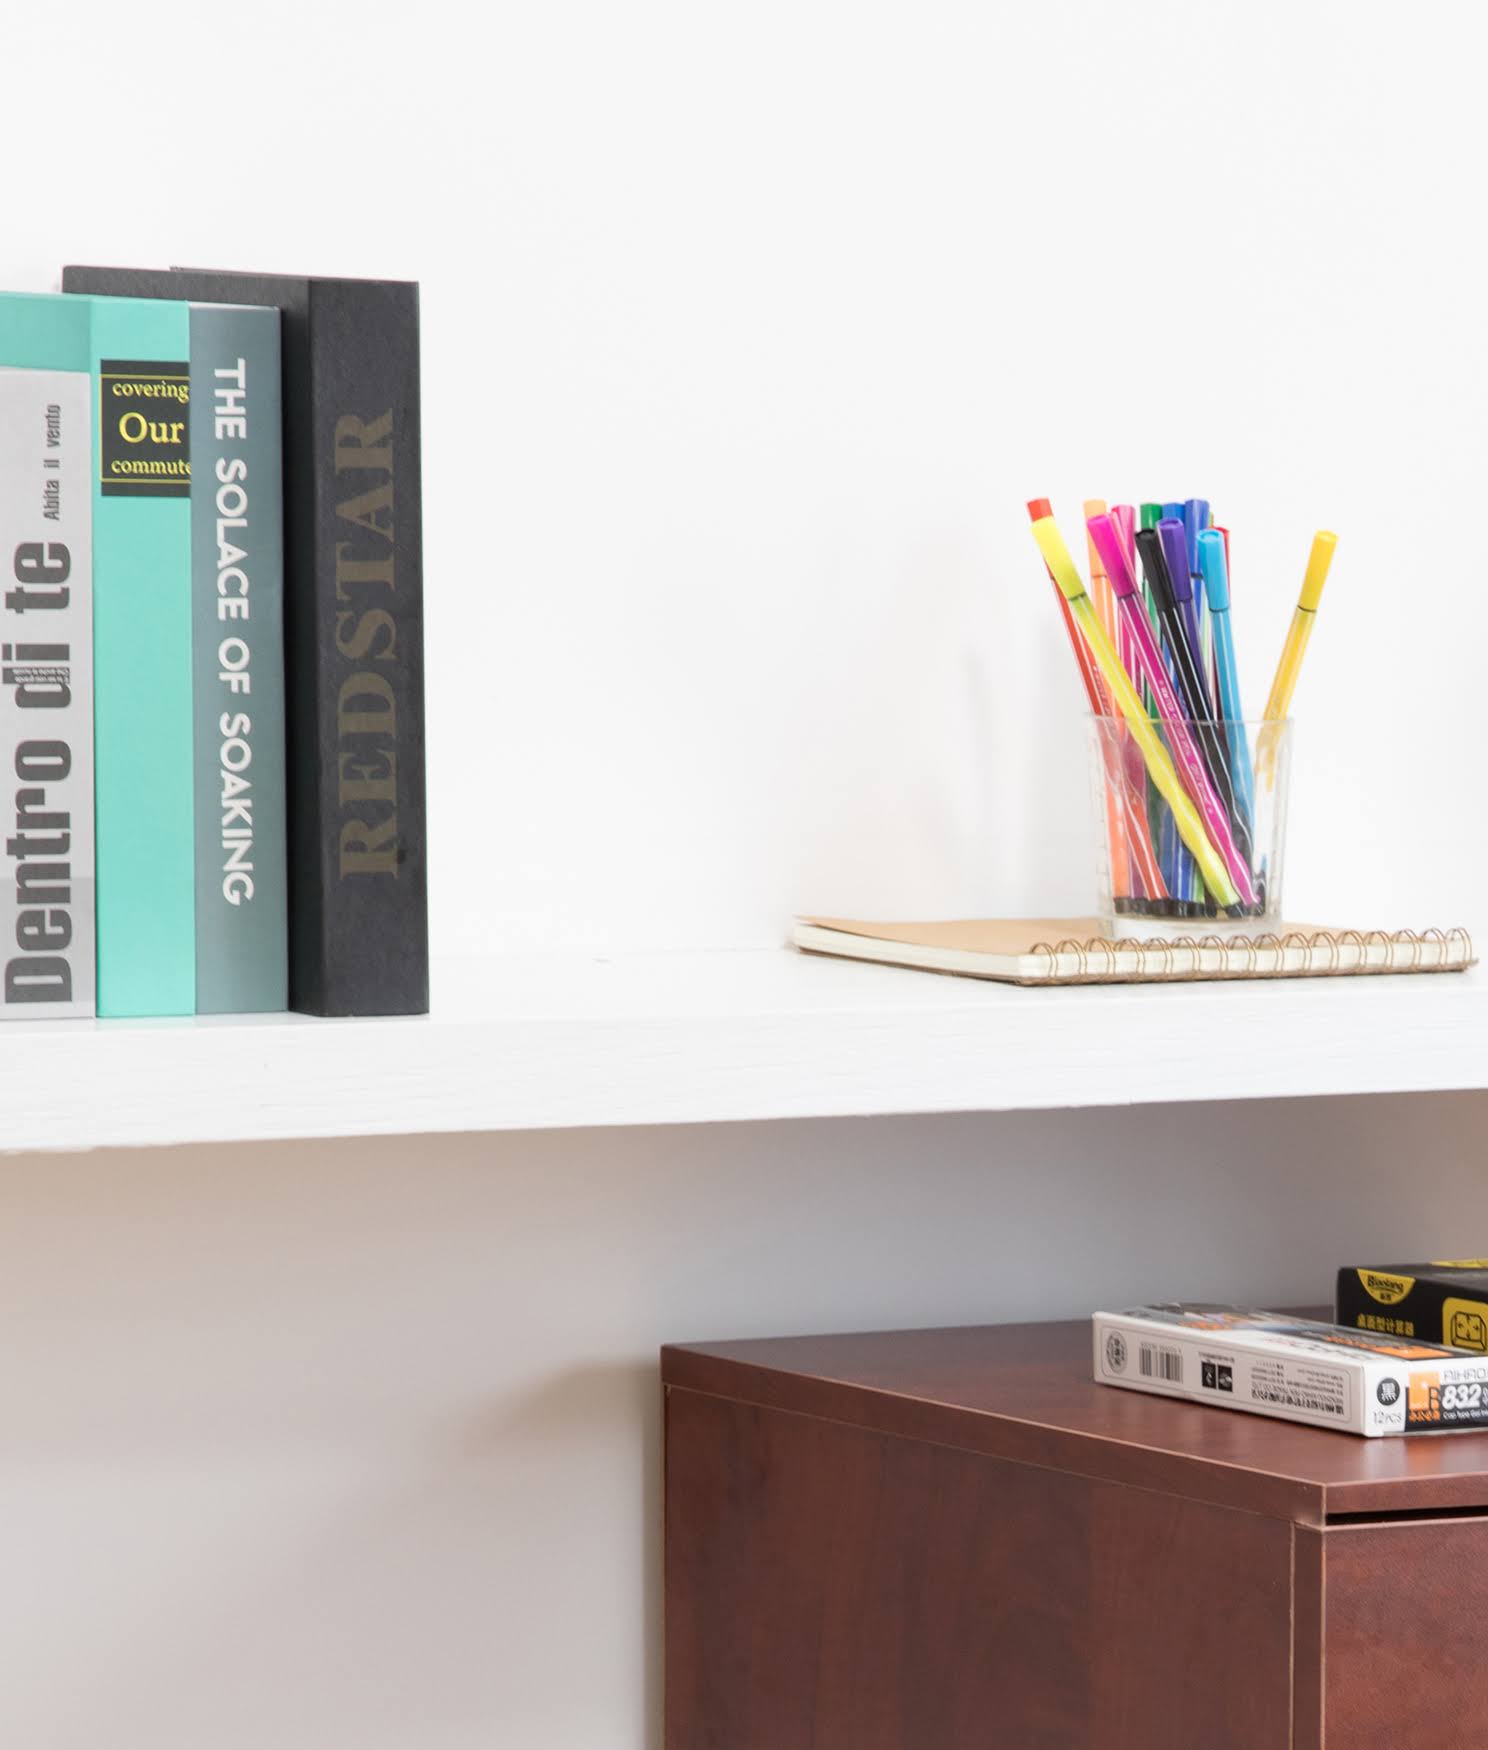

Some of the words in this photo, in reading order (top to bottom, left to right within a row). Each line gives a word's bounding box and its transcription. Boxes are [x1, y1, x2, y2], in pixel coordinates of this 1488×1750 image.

[112, 380, 190, 404] covering
[214, 358, 247, 440] THE
[45, 404, 61, 448] vento
[119, 411, 184, 444] Our
[43, 459, 60, 469] il
[43, 480, 61, 521] Abita
[215, 457, 249, 621] SOLACE
[5, 541, 72, 614] te
[2, 643, 72, 708] di
[218, 637, 251, 694] OF
[219, 712, 254, 906] SOAKING
[5, 739, 73, 1002] Dentro
[1381, 1382, 1397, 1401] 黑
[1442, 1383, 1481, 1410] 832
